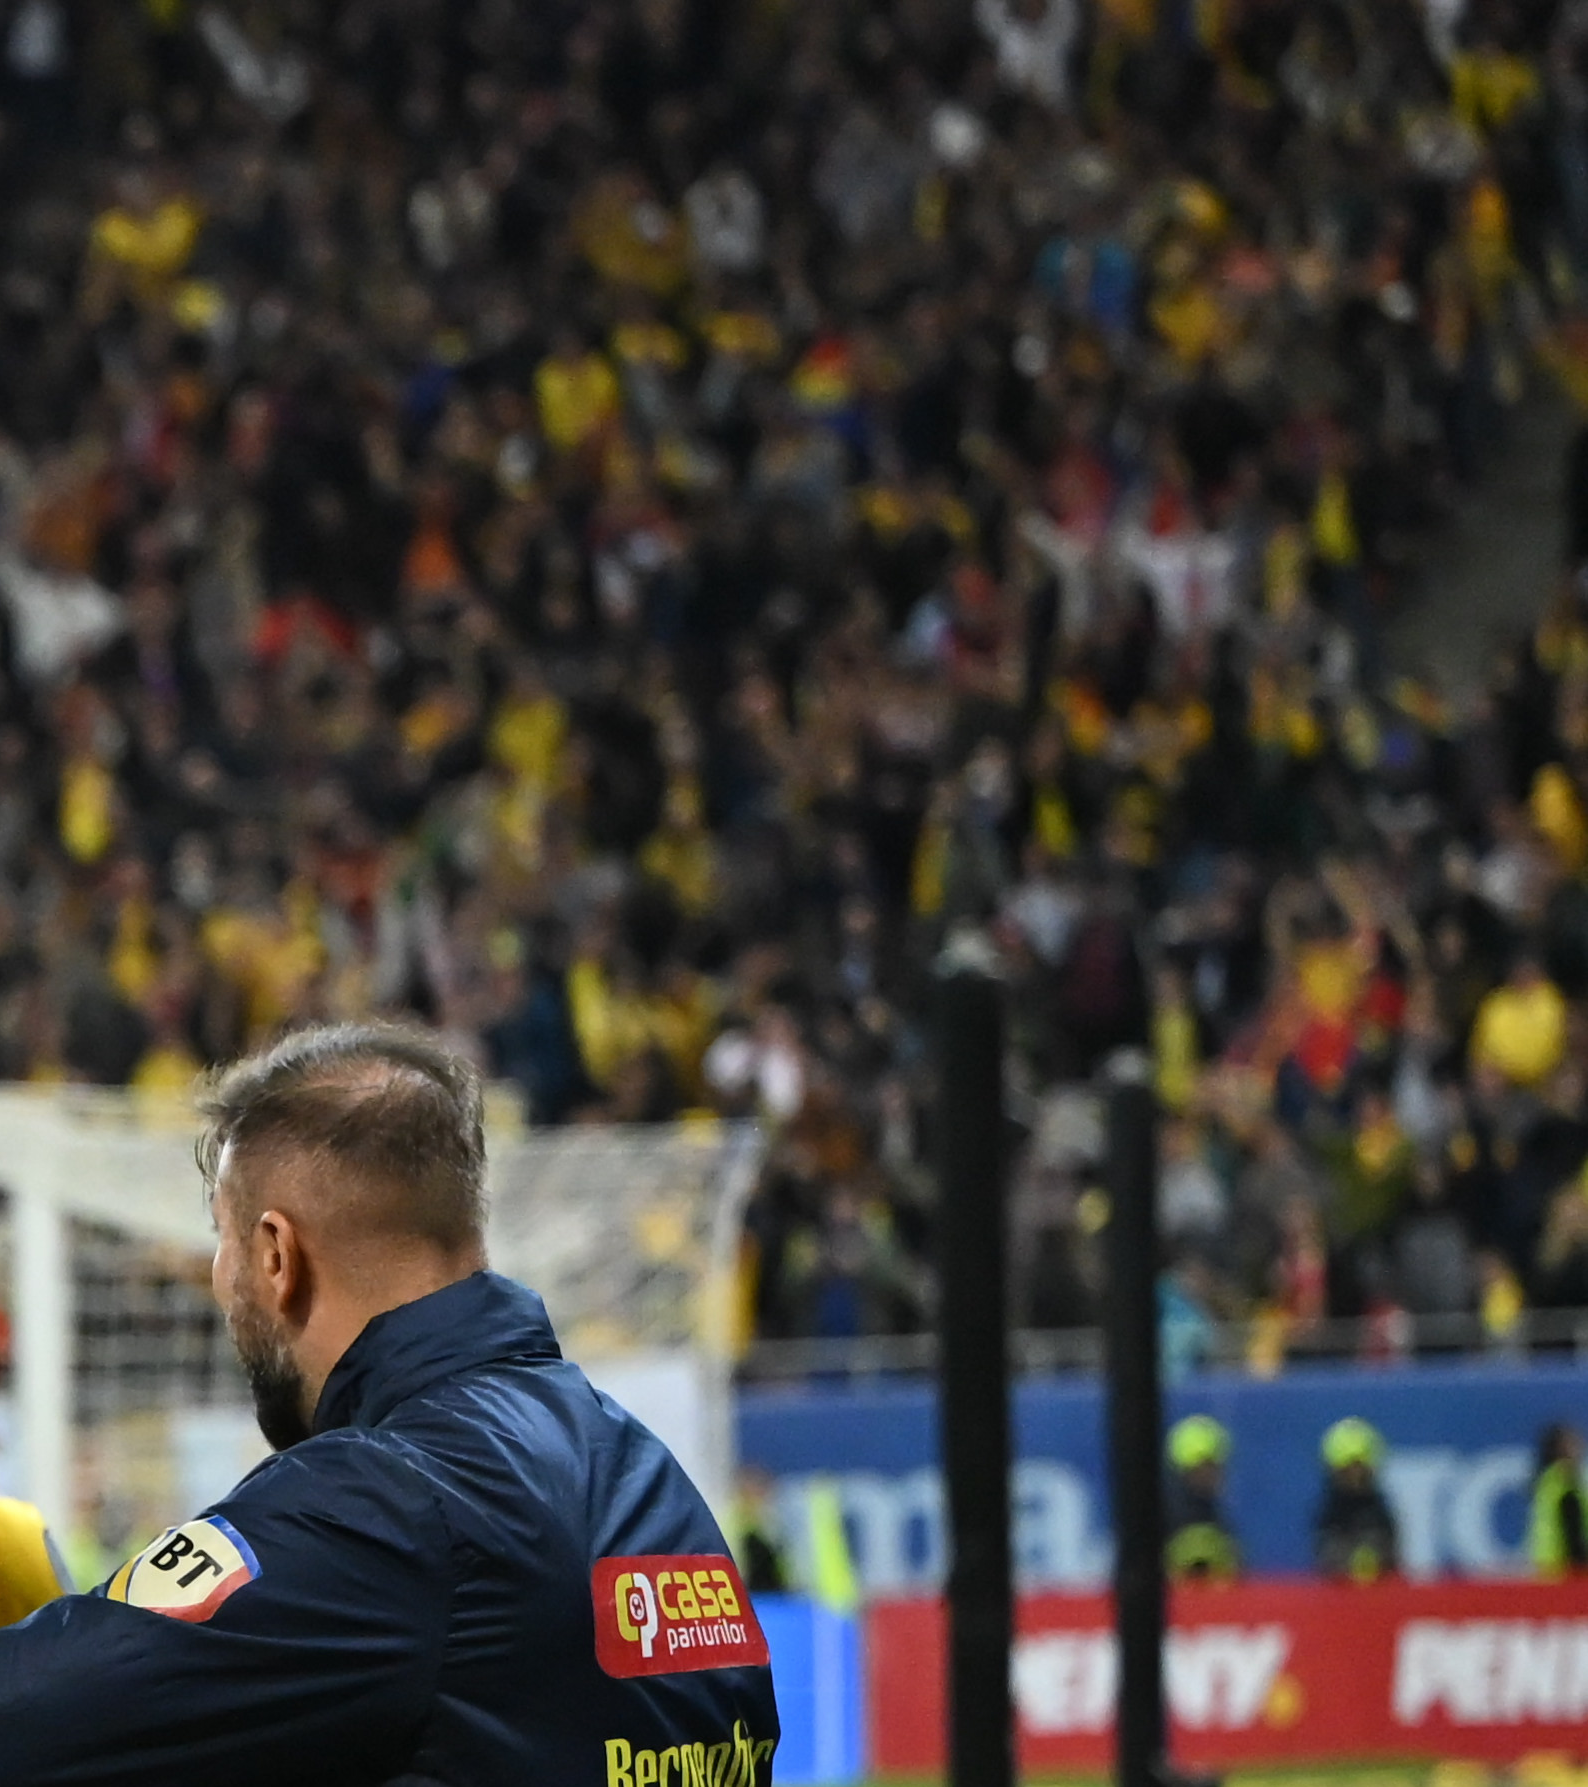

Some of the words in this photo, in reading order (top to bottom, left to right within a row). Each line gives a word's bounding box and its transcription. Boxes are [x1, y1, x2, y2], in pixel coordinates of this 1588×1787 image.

[149, 1532, 223, 1589] BT
[656, 1569, 741, 1620] casa
[666, 1617, 748, 1656] pariurilor
